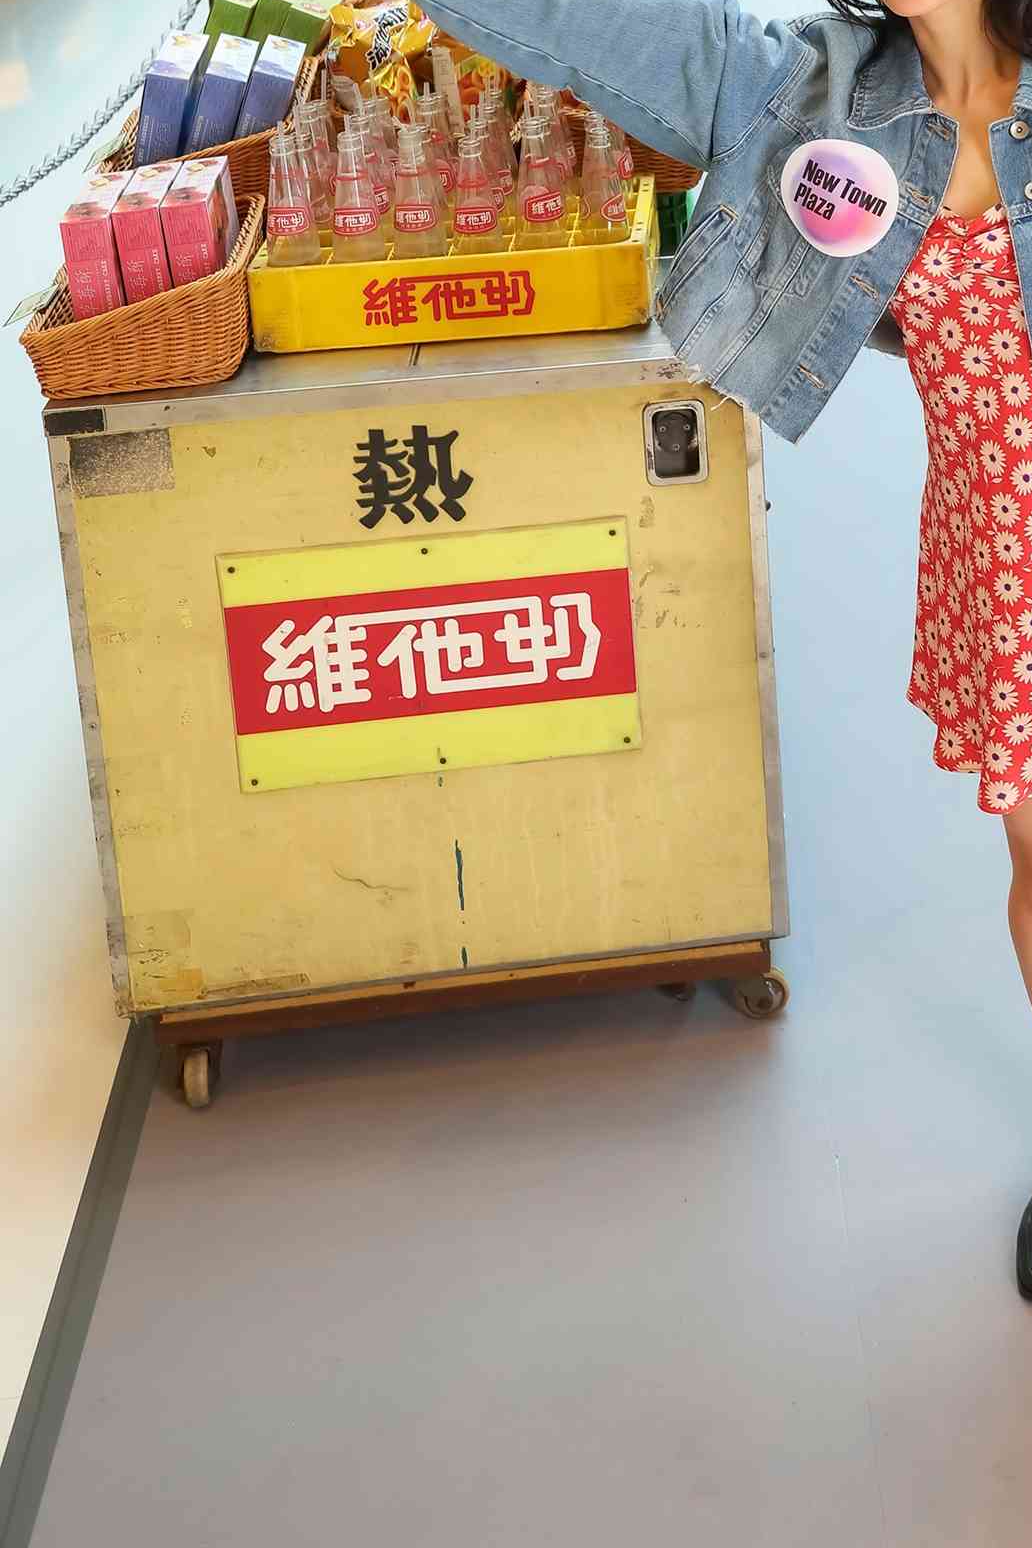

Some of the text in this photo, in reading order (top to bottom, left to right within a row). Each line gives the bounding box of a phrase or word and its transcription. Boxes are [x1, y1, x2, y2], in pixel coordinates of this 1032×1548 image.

[793, 182, 836, 221] Plaza
[802, 158, 888, 218] New Town
[362, 270, 536, 327] 維他奶
[351, 424, 474, 530] 熱
[261, 591, 602, 714] 維他奶
